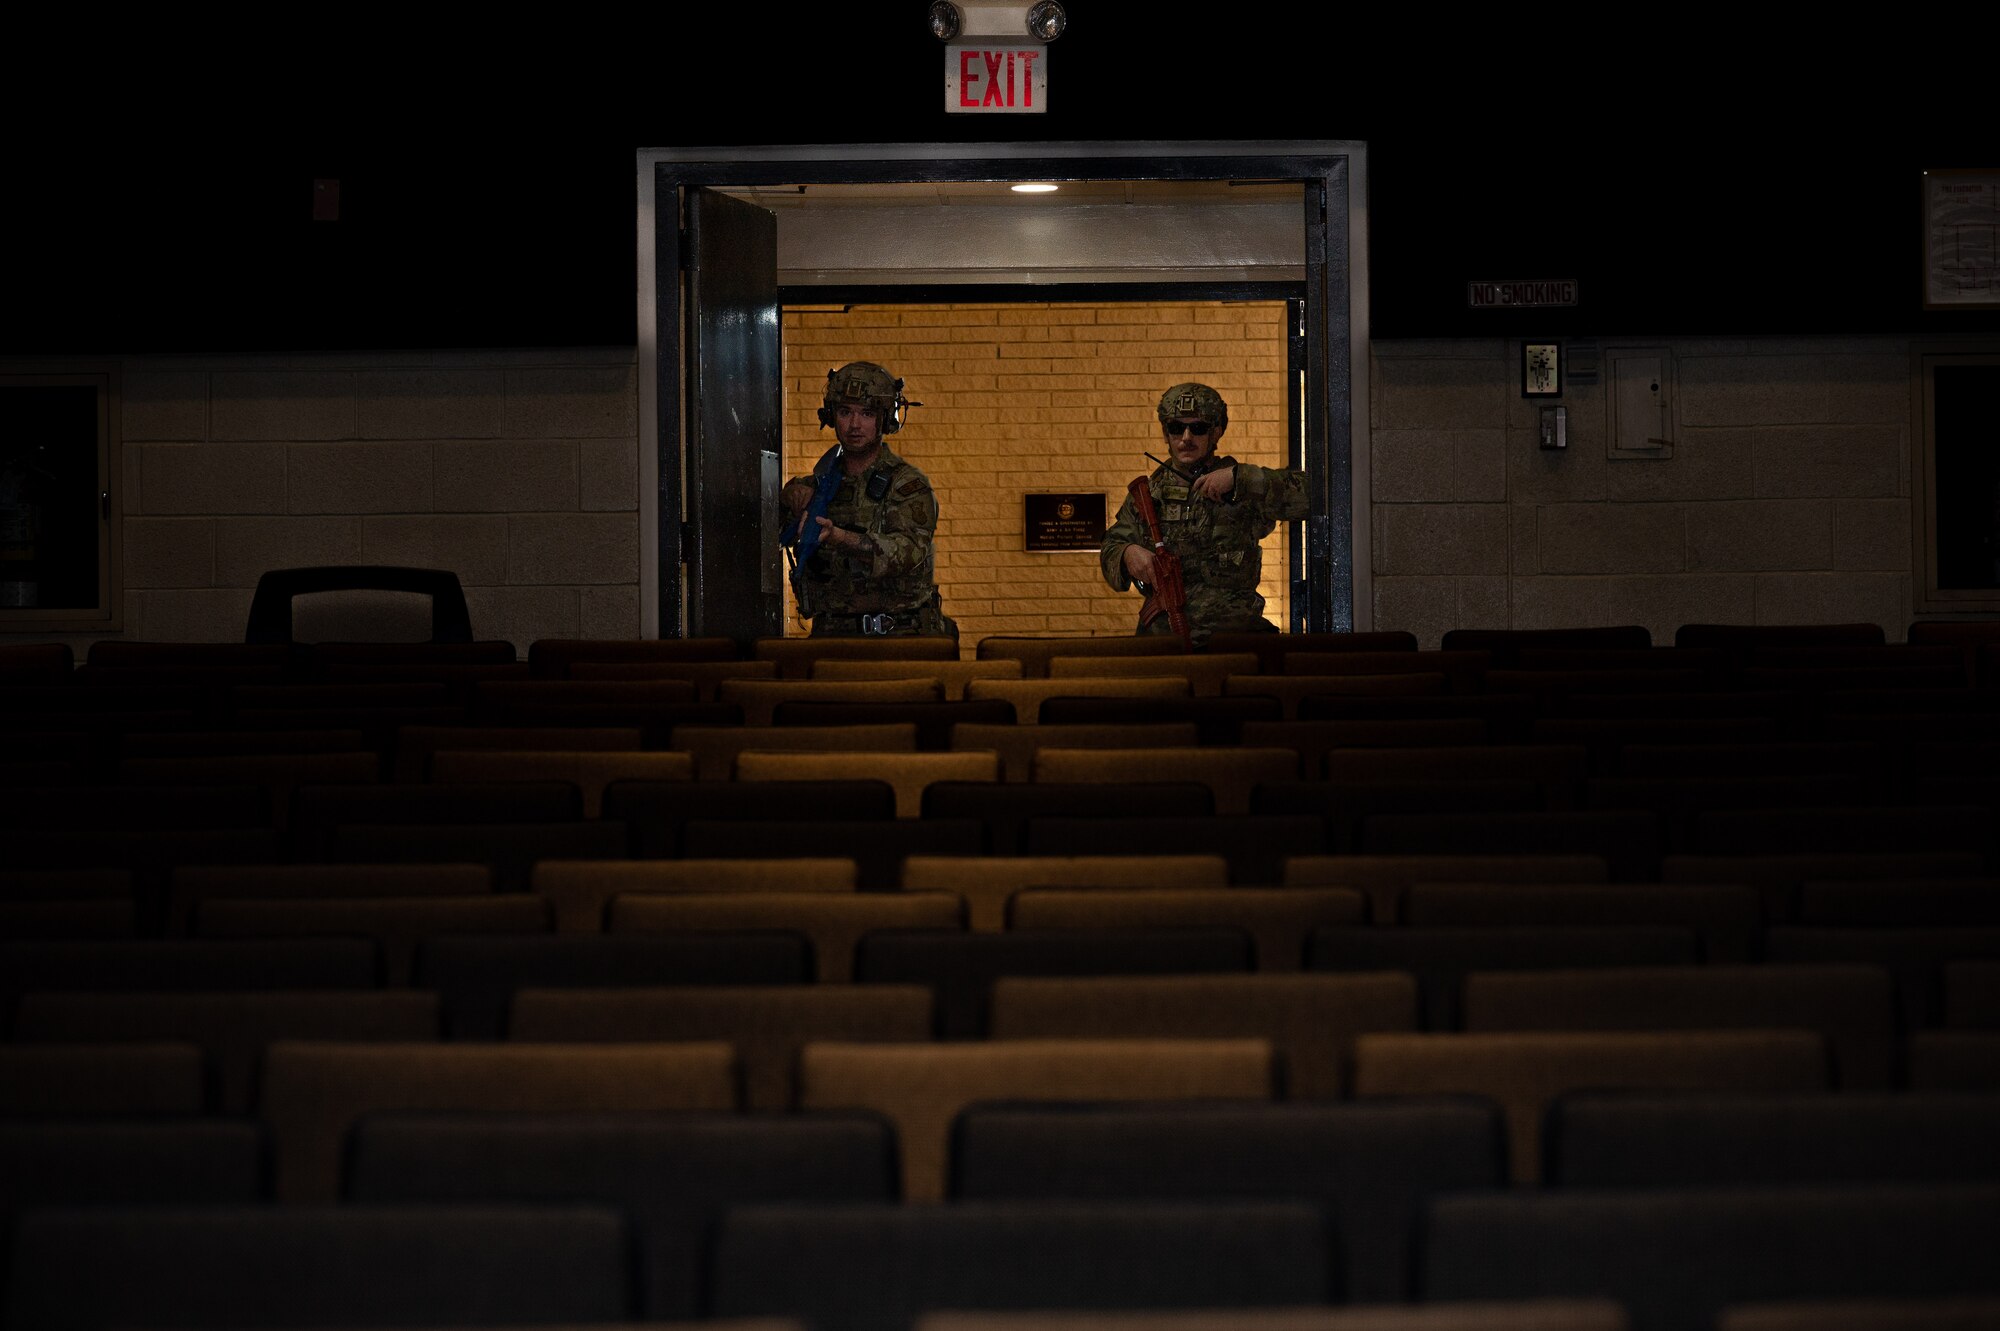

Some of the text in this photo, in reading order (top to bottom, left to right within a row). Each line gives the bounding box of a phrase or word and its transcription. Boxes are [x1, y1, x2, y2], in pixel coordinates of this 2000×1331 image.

[960, 51, 1039, 107] EXIT
[1473, 283, 1572, 304] NO SMOKING
